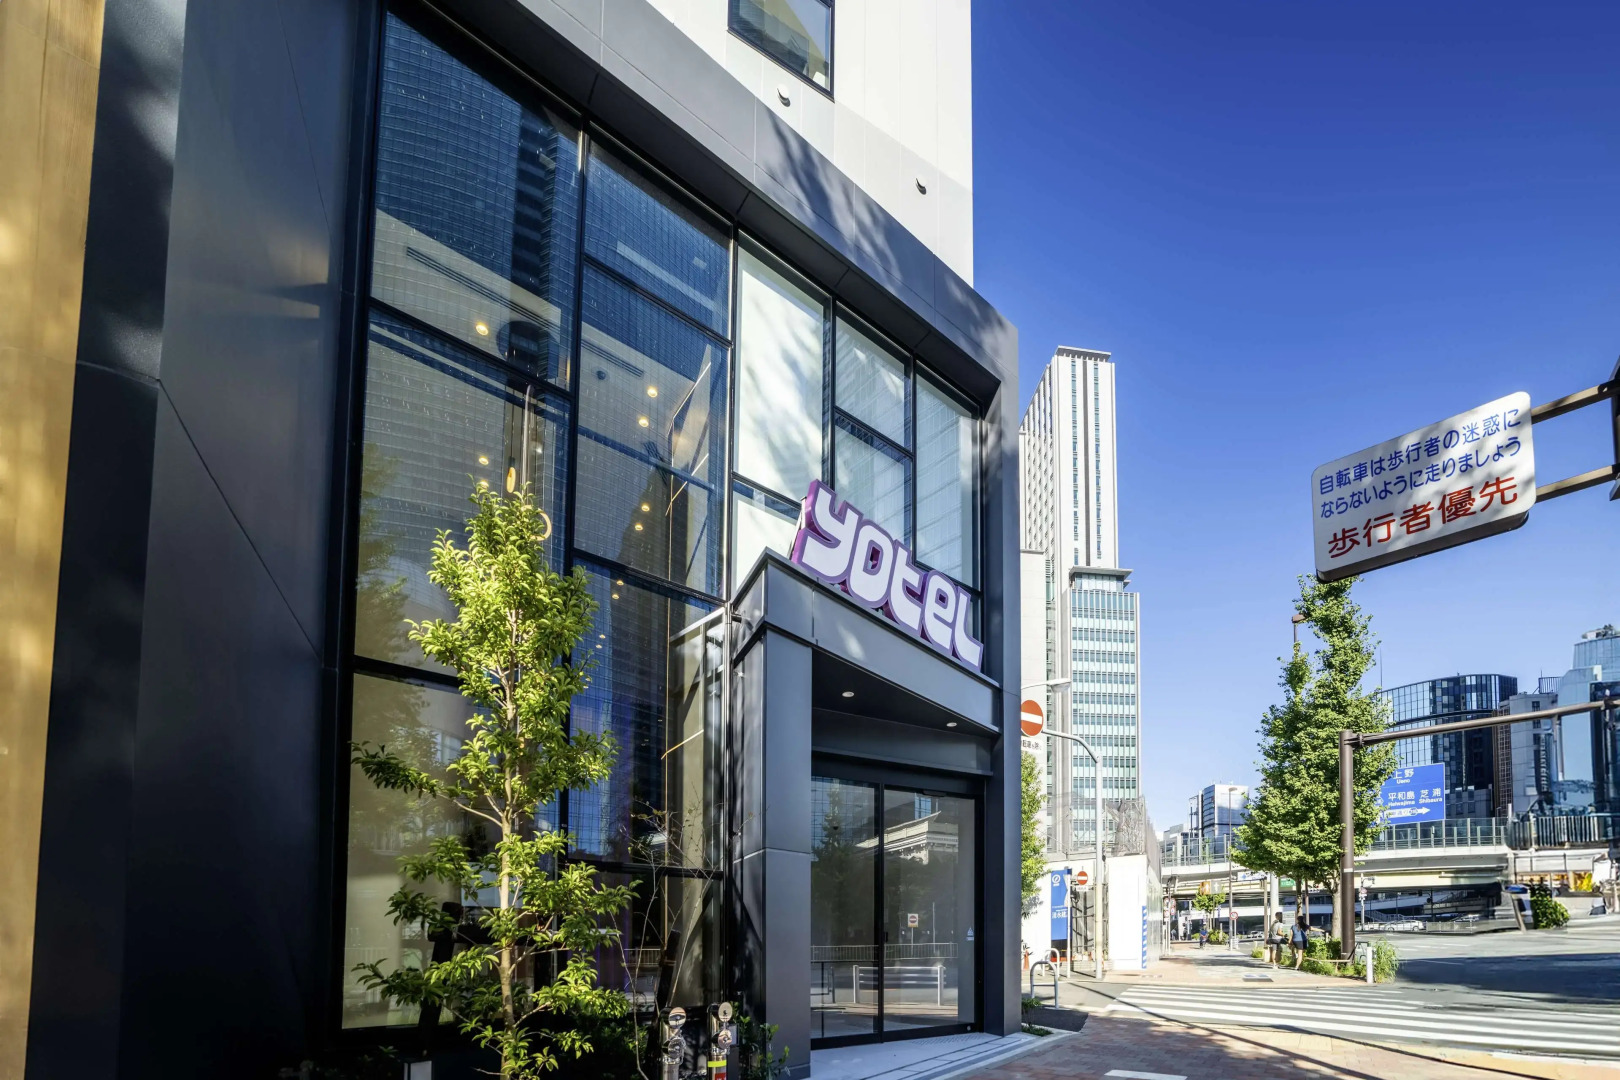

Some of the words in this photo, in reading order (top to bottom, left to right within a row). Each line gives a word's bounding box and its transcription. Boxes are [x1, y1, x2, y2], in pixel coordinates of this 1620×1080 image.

[1319, 408, 1521, 495] 自転車は歩行者の迷惑に
[1320, 436, 1522, 519] ならないように走りましょう
[1328, 476, 1518, 559] 歩行者優先
[1388, 791, 1415, 801] 平和島
[1420, 788, 1442, 798] 芝浦
[1393, 769, 1414, 779] 上野
